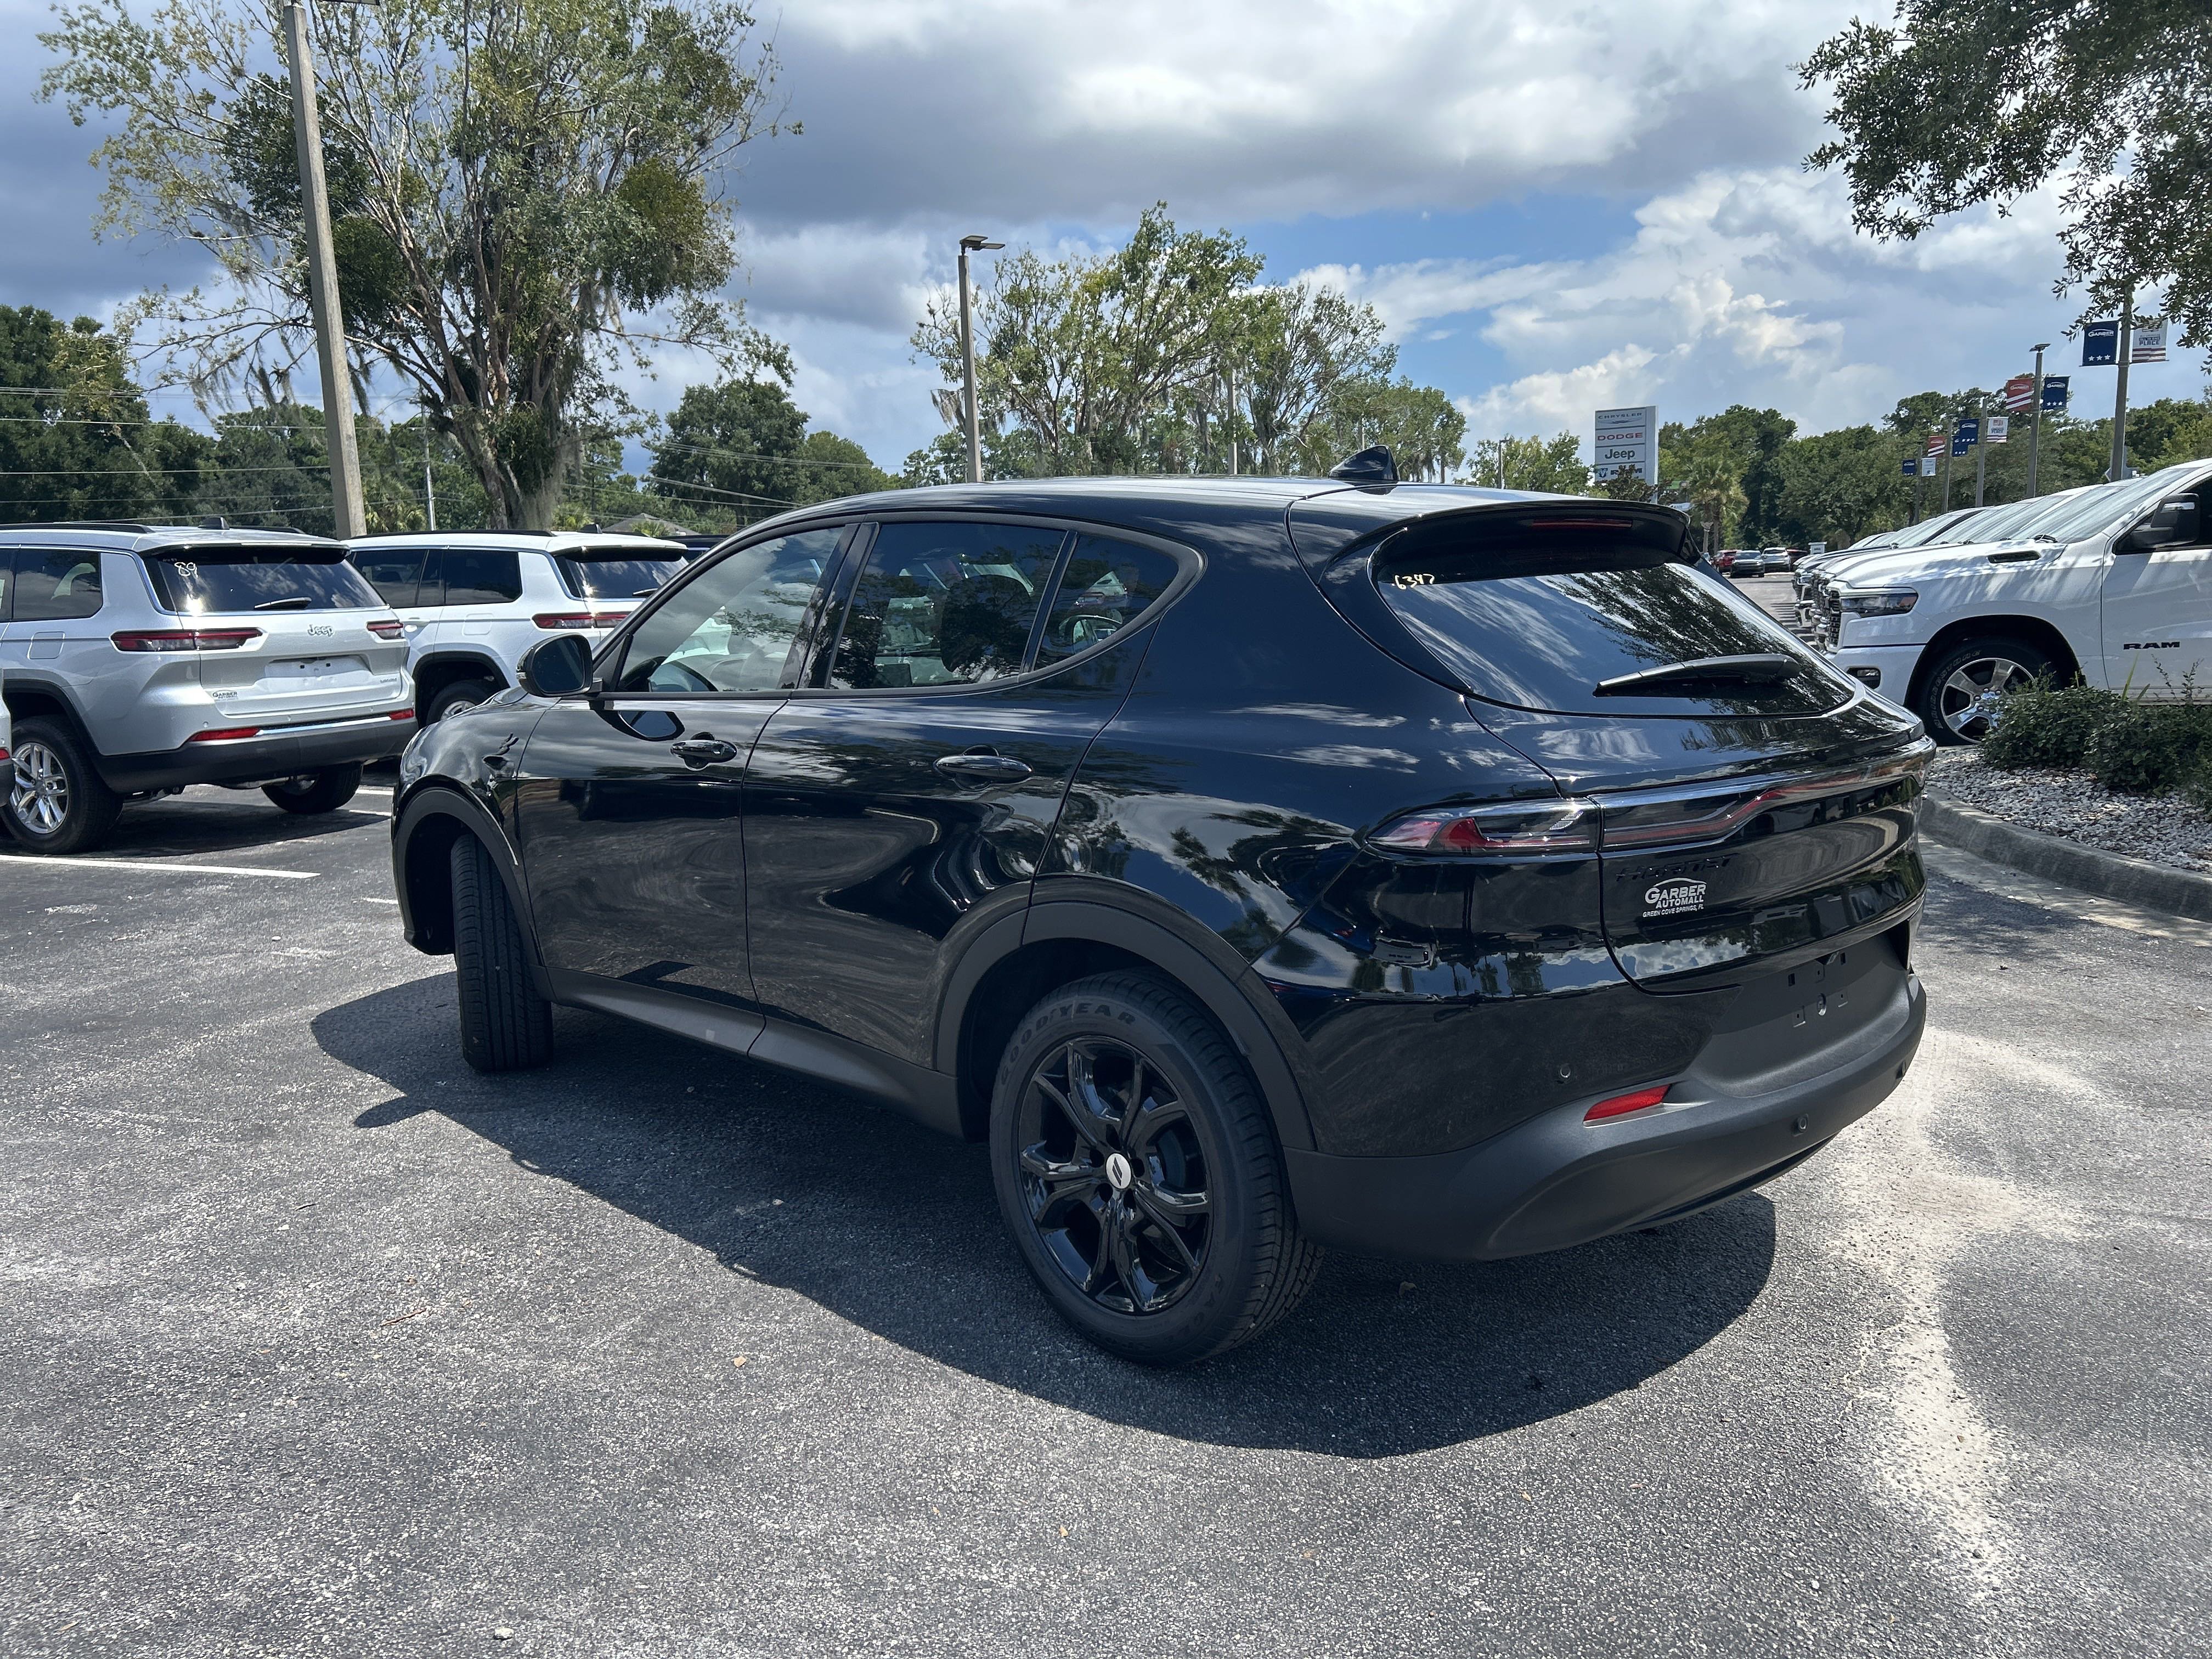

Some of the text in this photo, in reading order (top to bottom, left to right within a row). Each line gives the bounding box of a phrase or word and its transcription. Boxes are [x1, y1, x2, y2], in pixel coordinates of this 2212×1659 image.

[1598, 432, 1643, 441] DODGE
[1605, 449, 1635, 460] Jeep
[174, 562, 198, 578] 89
[307, 624, 333, 637] Jeep
[2123, 641, 2180, 650] RAM
[1645, 884, 1706, 904] GARBER
[1655, 895, 1704, 909] AUTOMALL
[1675, 905, 1697, 913] SPRINGS,
[1001, 1002, 1136, 1085] GOODYEAR
